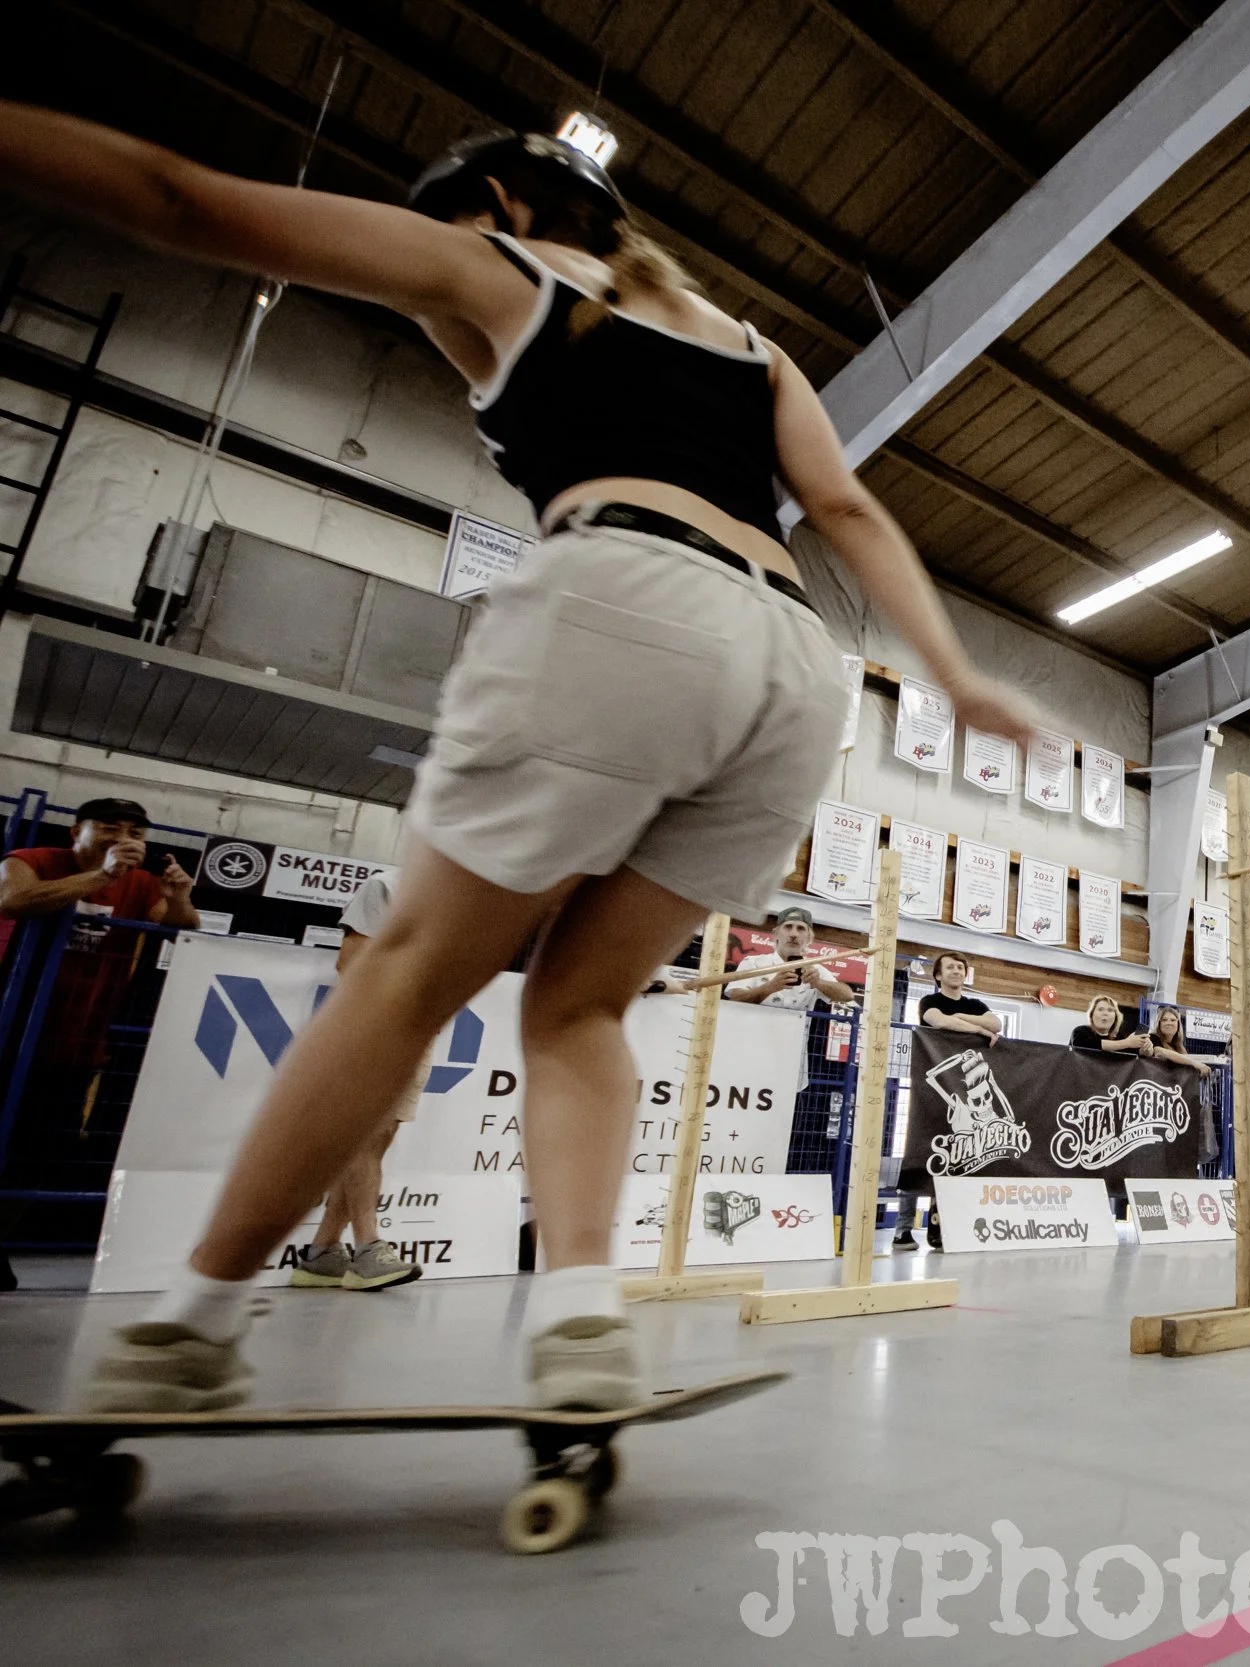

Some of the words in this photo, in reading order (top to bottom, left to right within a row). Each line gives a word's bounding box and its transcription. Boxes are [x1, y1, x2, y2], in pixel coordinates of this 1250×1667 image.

[457, 563, 493, 581] 2015
[922, 695, 940, 711] 025
[1041, 741, 1062, 755] 2025
[1095, 757, 1113, 770] 2024
[833, 816, 862, 833] 2024
[907, 834, 932, 850] 2024
[278, 853, 384, 880] SKATEB
[972, 855, 995, 870] 2023
[301, 873, 363, 894] MUS
[1033, 871, 1055, 883] 2022
[896, 1043, 908, 1054] 50
[868, 1096, 882, 1105] 20
[1050, 1080, 1191, 1170] SUAVECITO
[926, 1119, 1032, 1177] SUAVECITO
[473, 1150, 765, 1175] MACTRING
[398, 1186, 442, 1208] Inn
[979, 1184, 1073, 1207] JOECORP
[1137, 1205, 1165, 1218] BONES
[993, 1218, 1089, 1243] Skullcandy
